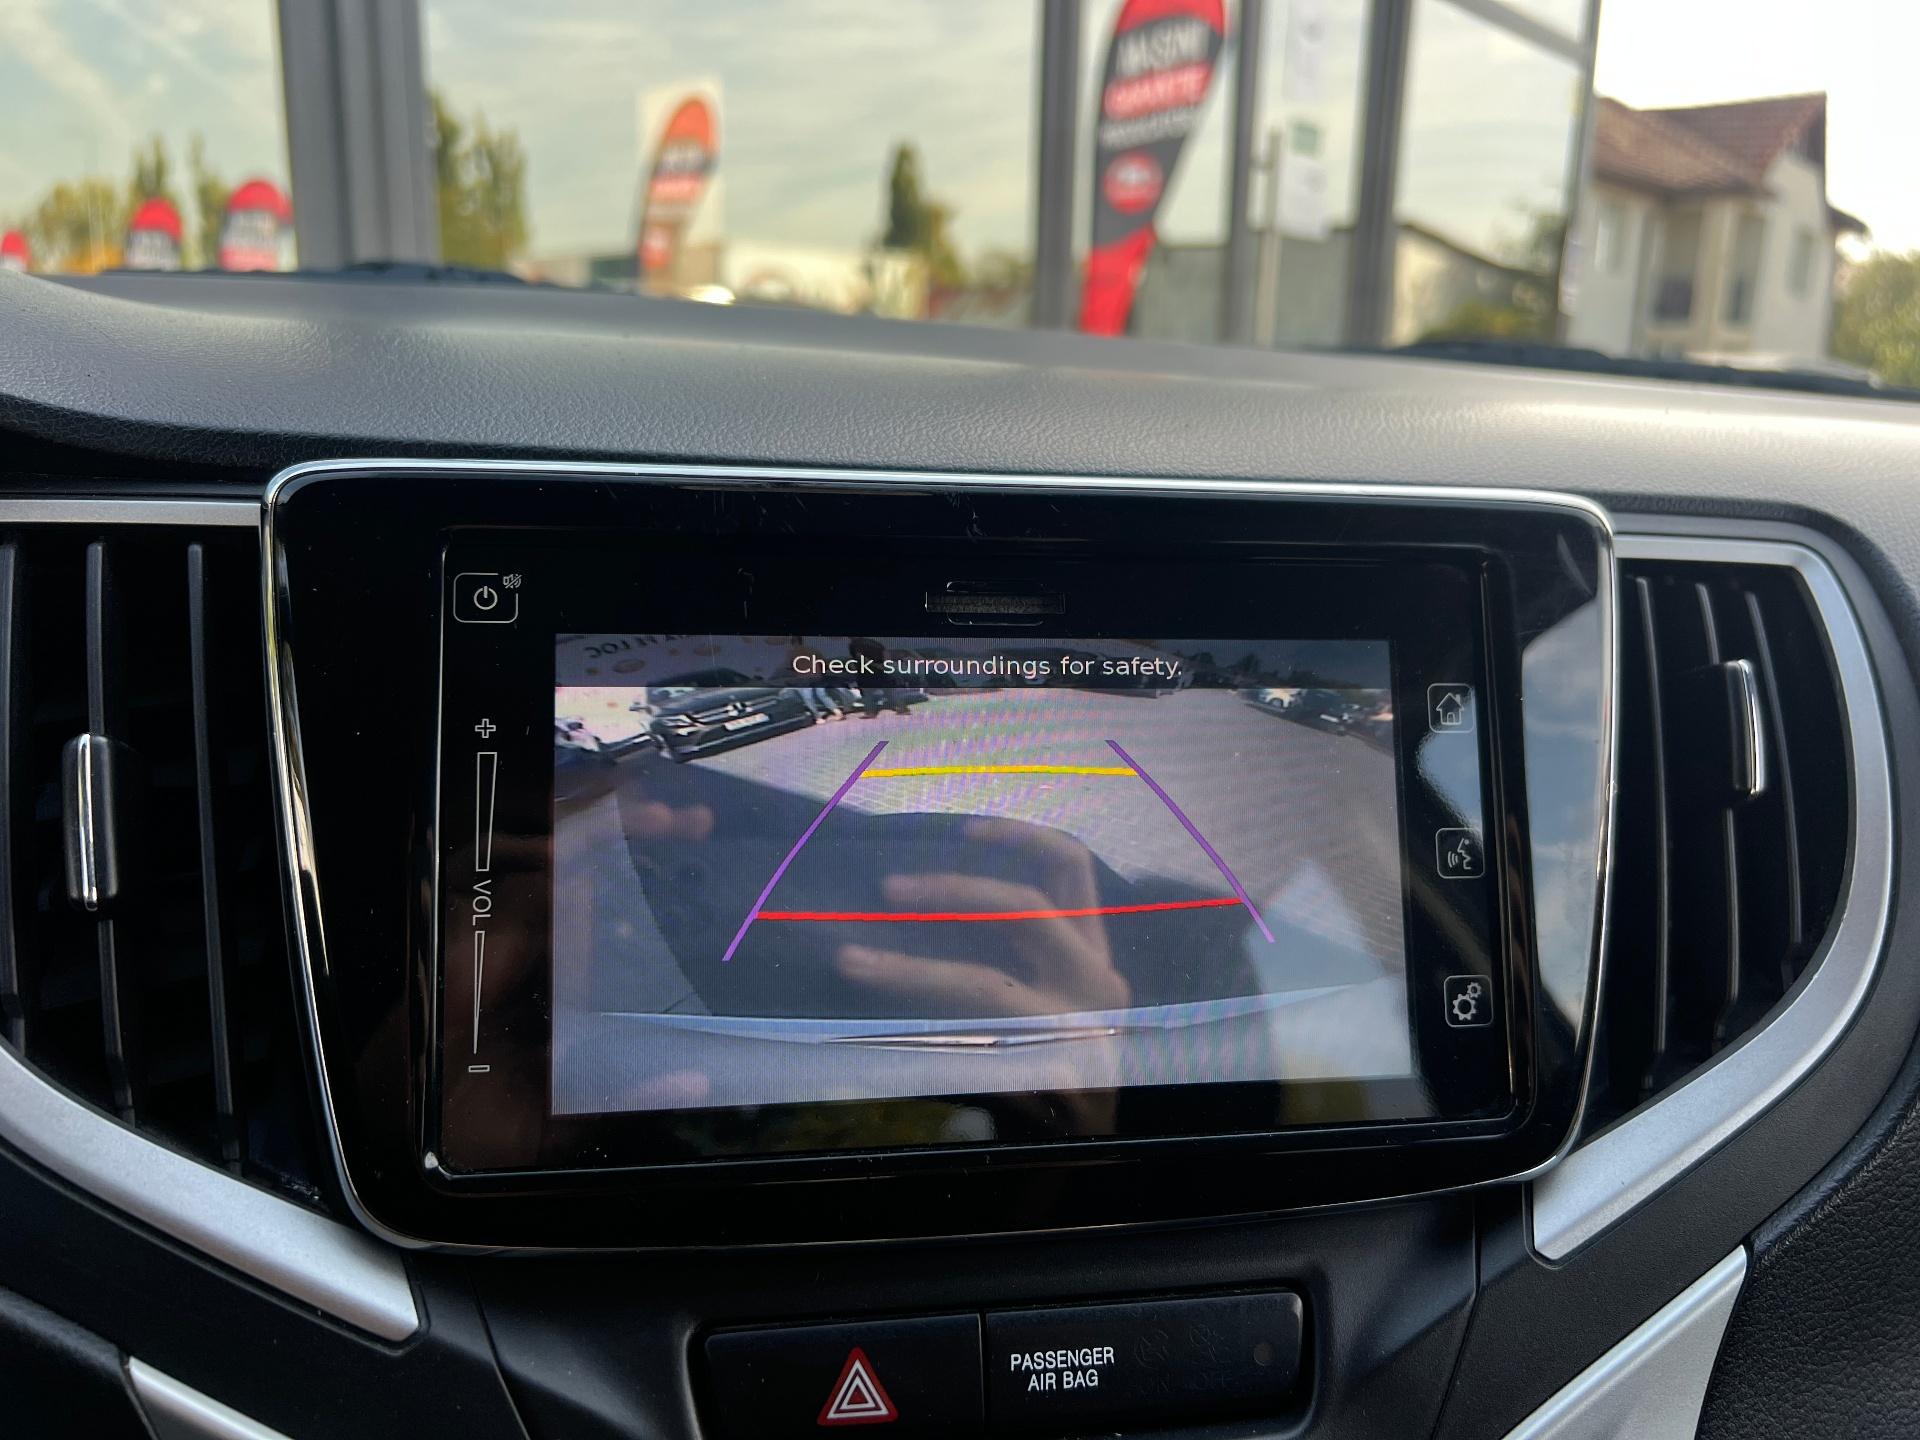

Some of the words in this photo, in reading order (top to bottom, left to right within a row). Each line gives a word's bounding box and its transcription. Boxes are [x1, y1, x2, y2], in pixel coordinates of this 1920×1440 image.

[792, 654, 875, 675] Check
[883, 655, 1051, 679] surroundings
[1060, 656, 1095, 675] for
[1102, 656, 1182, 680] safety.
[472, 879, 492, 926] VOL
[1009, 1346, 1115, 1372] PASSENGER
[1027, 1370, 1057, 1392] AIR
[1063, 1368, 1099, 1389] BAG
